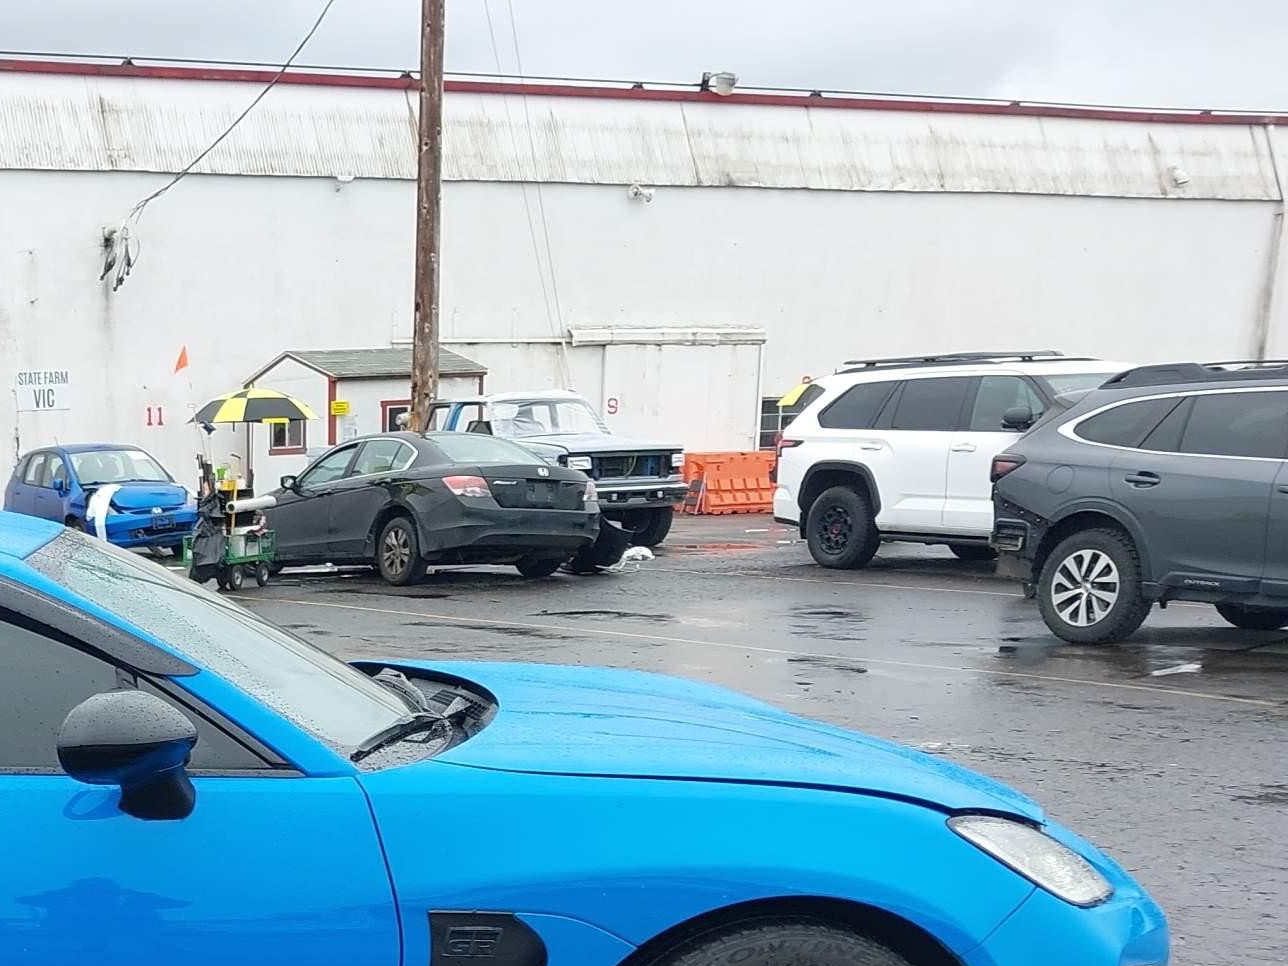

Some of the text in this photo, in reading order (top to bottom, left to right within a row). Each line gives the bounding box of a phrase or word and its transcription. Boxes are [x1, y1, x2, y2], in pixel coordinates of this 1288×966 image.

[18, 371, 69, 386] STATE FARM
[33, 389, 55, 408] VIC
[146, 407, 164, 426] 11
